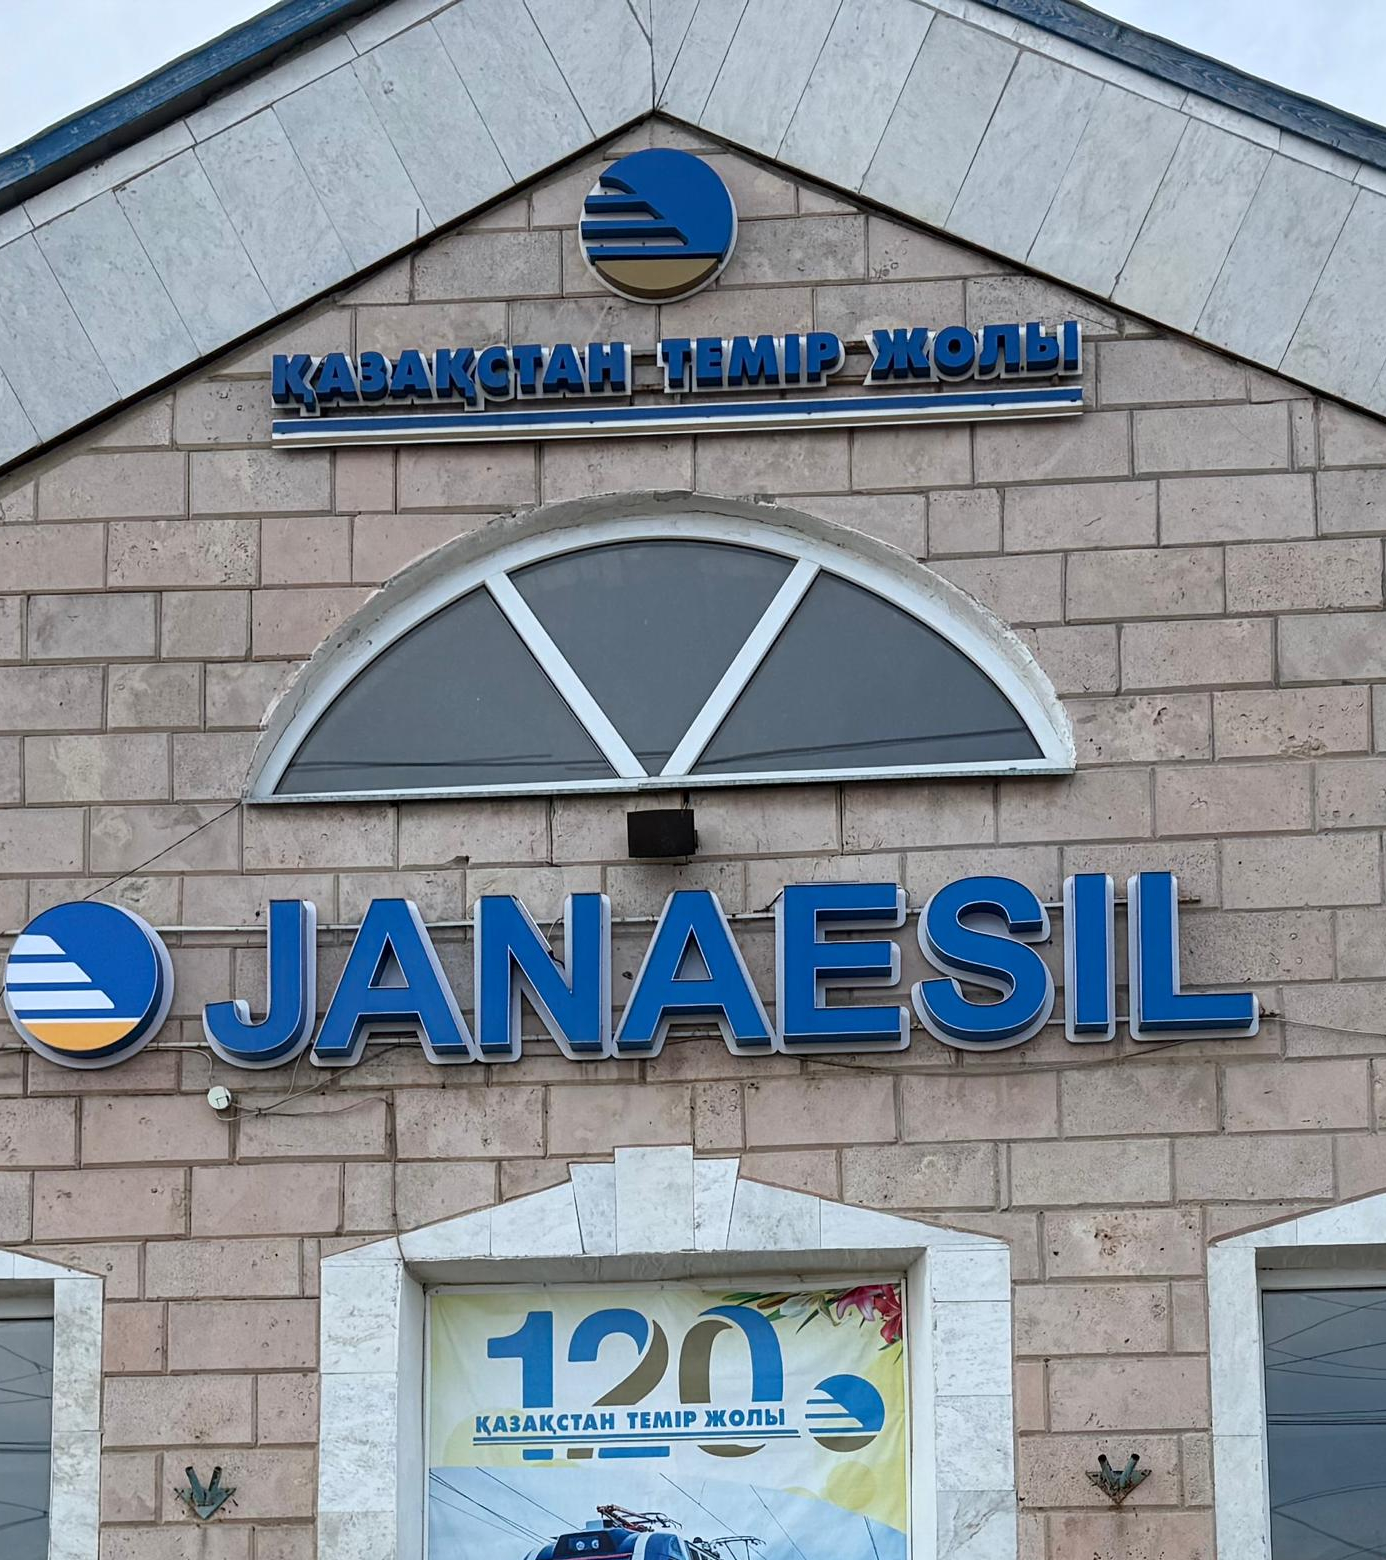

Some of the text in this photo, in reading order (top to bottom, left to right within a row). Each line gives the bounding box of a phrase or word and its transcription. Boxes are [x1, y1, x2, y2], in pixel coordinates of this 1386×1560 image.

[272, 320, 1080, 410] ҚАЗАҚСТАН ТЕМІР ЖОЛЫ
[204, 871, 1258, 1063] JANAESIL
[475, 1408, 785, 1434] ҚАЗАҚСТАН ТЕМІР ЖОЛЫ
[487, 1305, 784, 1460] 120
